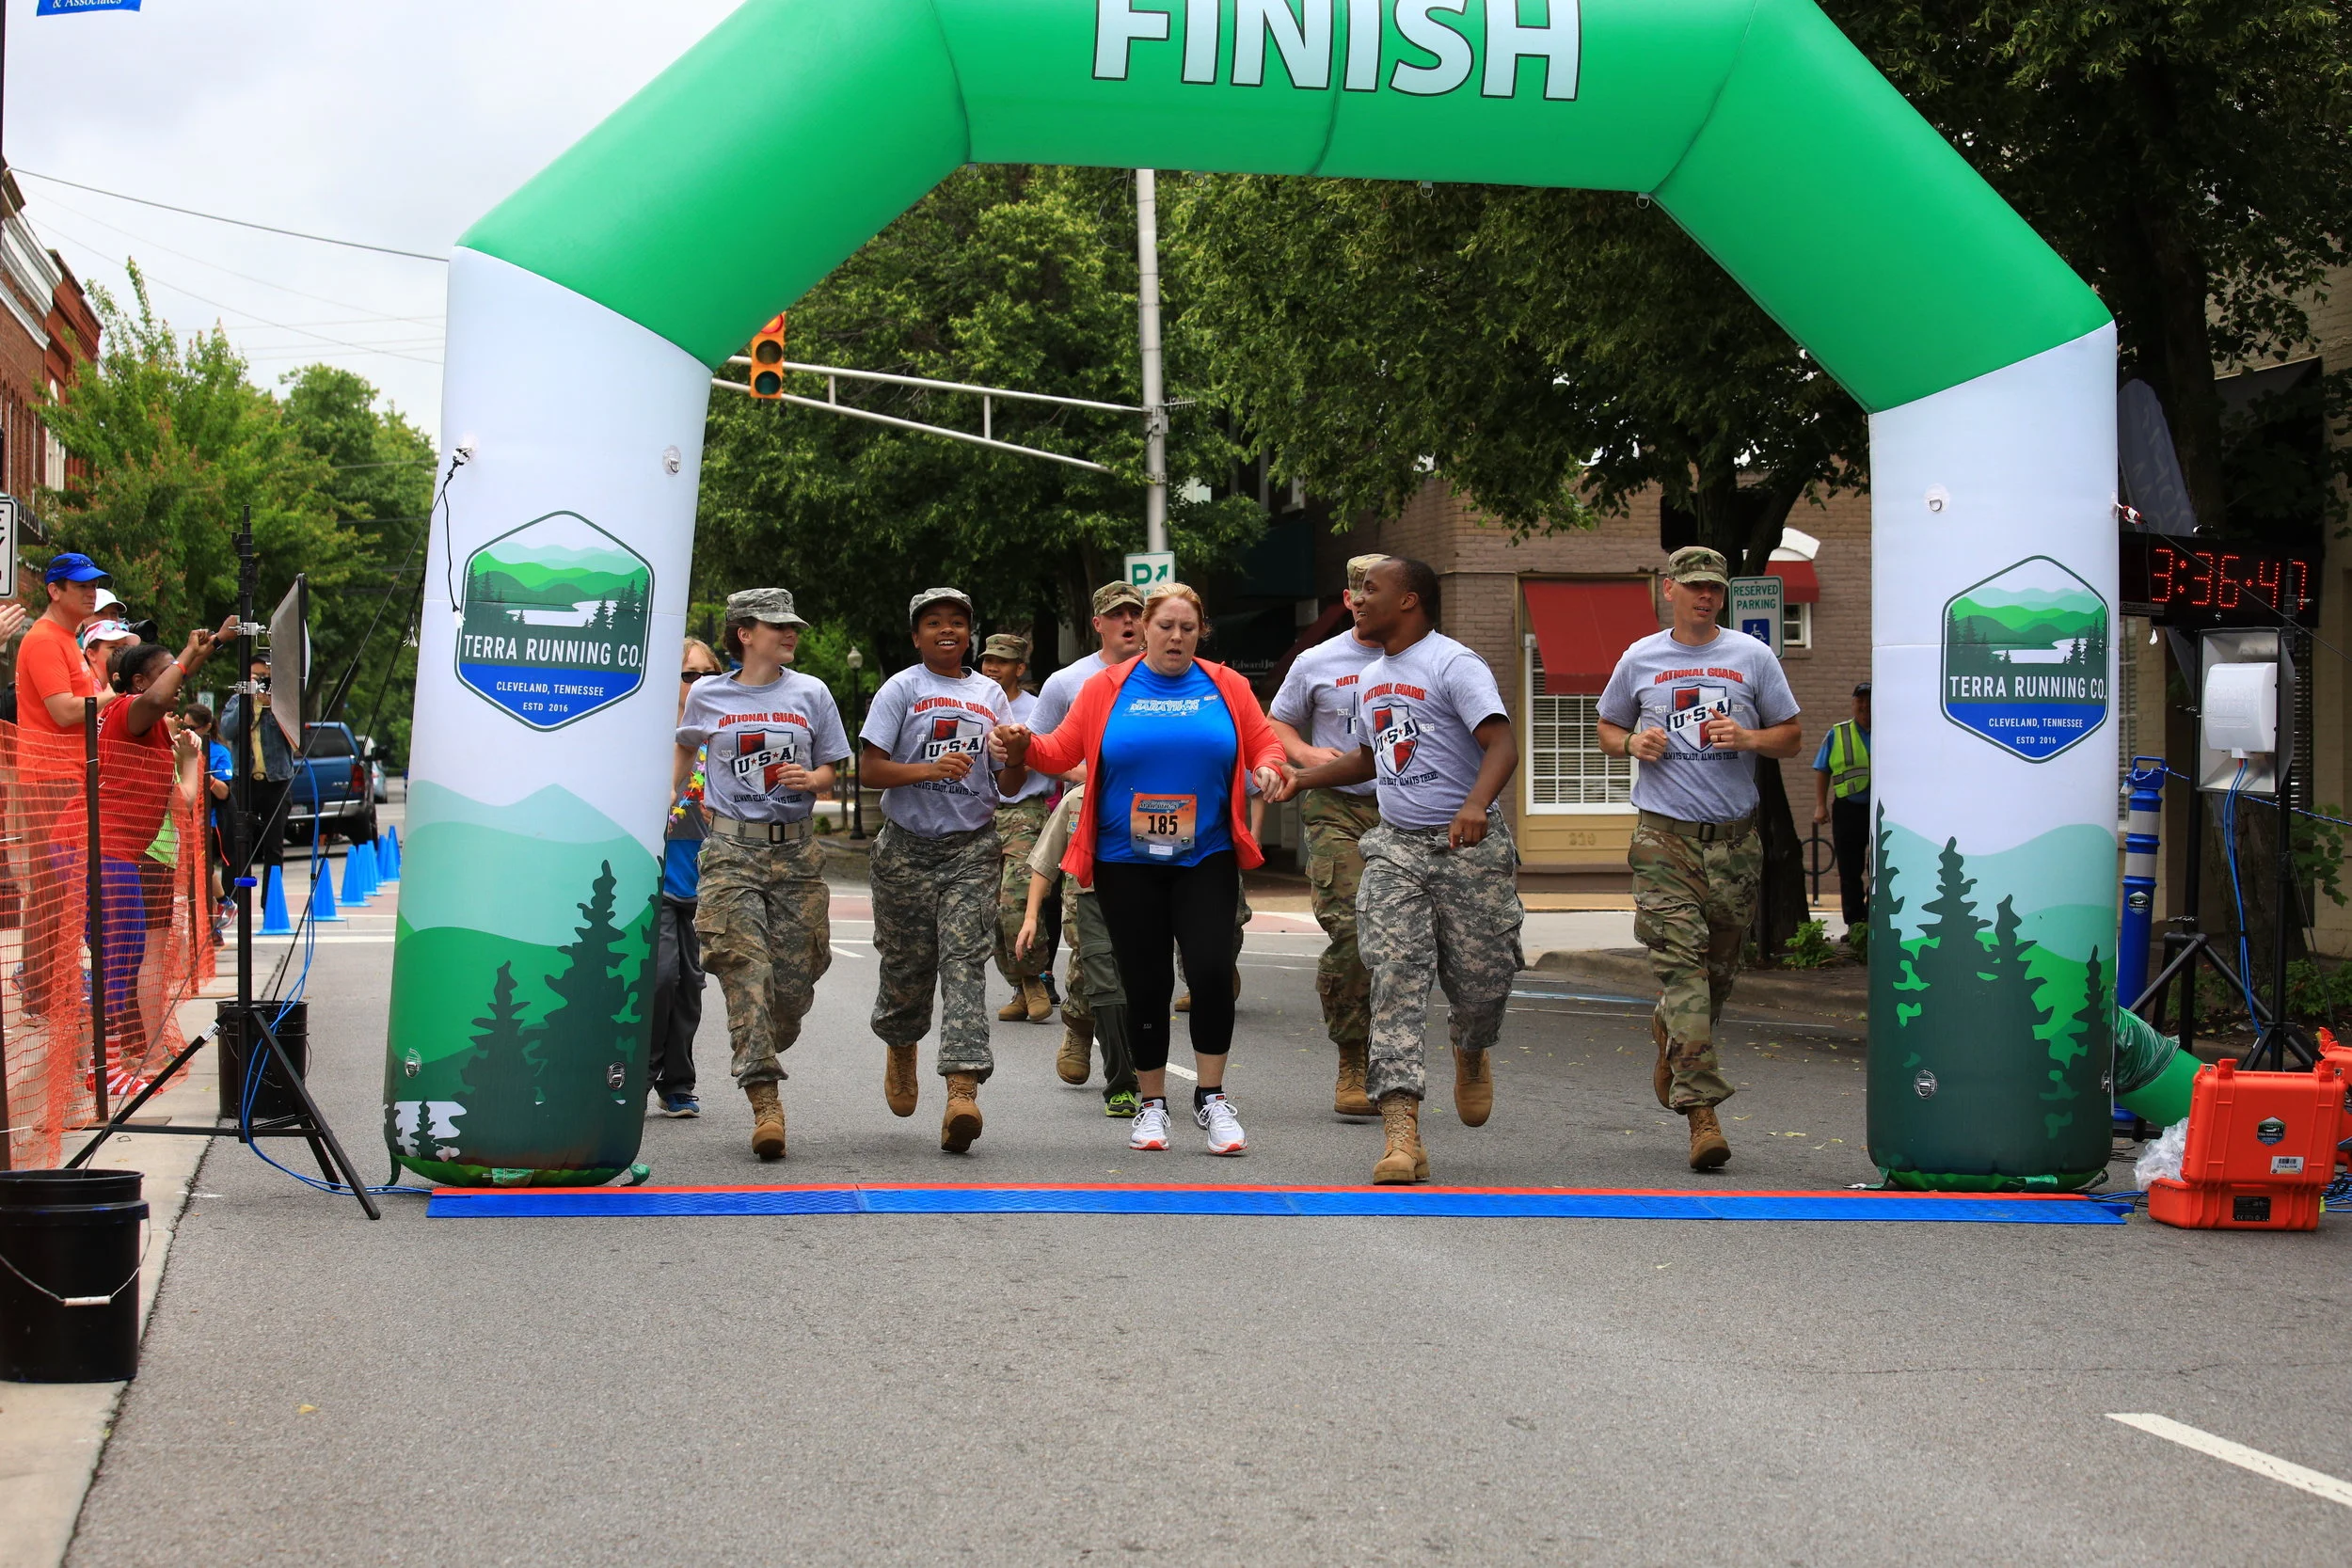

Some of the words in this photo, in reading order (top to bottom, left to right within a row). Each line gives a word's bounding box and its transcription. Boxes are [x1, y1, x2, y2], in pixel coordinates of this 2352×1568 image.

[1091, 0, 1581, 101] FINISH
[1132, 563, 1152, 586] P
[1734, 585, 1778, 596] RESERVED
[1737, 599, 1776, 610] PARKING
[464, 635, 517, 659] TERRA
[526, 639, 611, 665] RUNNING
[618, 644, 642, 668] CO.
[1654, 669, 1705, 685] NATIONAL
[1707, 668, 1743, 684] GUARD
[496, 681, 550, 695] CLEVELAND,
[554, 685, 604, 696] TENNESSEE
[1394, 683, 1425, 701] GUARD
[1949, 675, 2007, 697] TERRA
[2014, 676, 2086, 698] RUNNING
[2090, 677, 2106, 699] CO.
[523, 702, 544, 711] ESTD
[548, 703, 568, 712] 2016
[914, 697, 964, 714] NATIONAL
[718, 712, 770, 729] NATIONAL
[771, 712, 808, 729] GUARD
[1989, 718, 2040, 728] CLEVELAND,
[2042, 718, 2083, 728] TENNESSEE
[1148, 815, 1178, 835] 185
